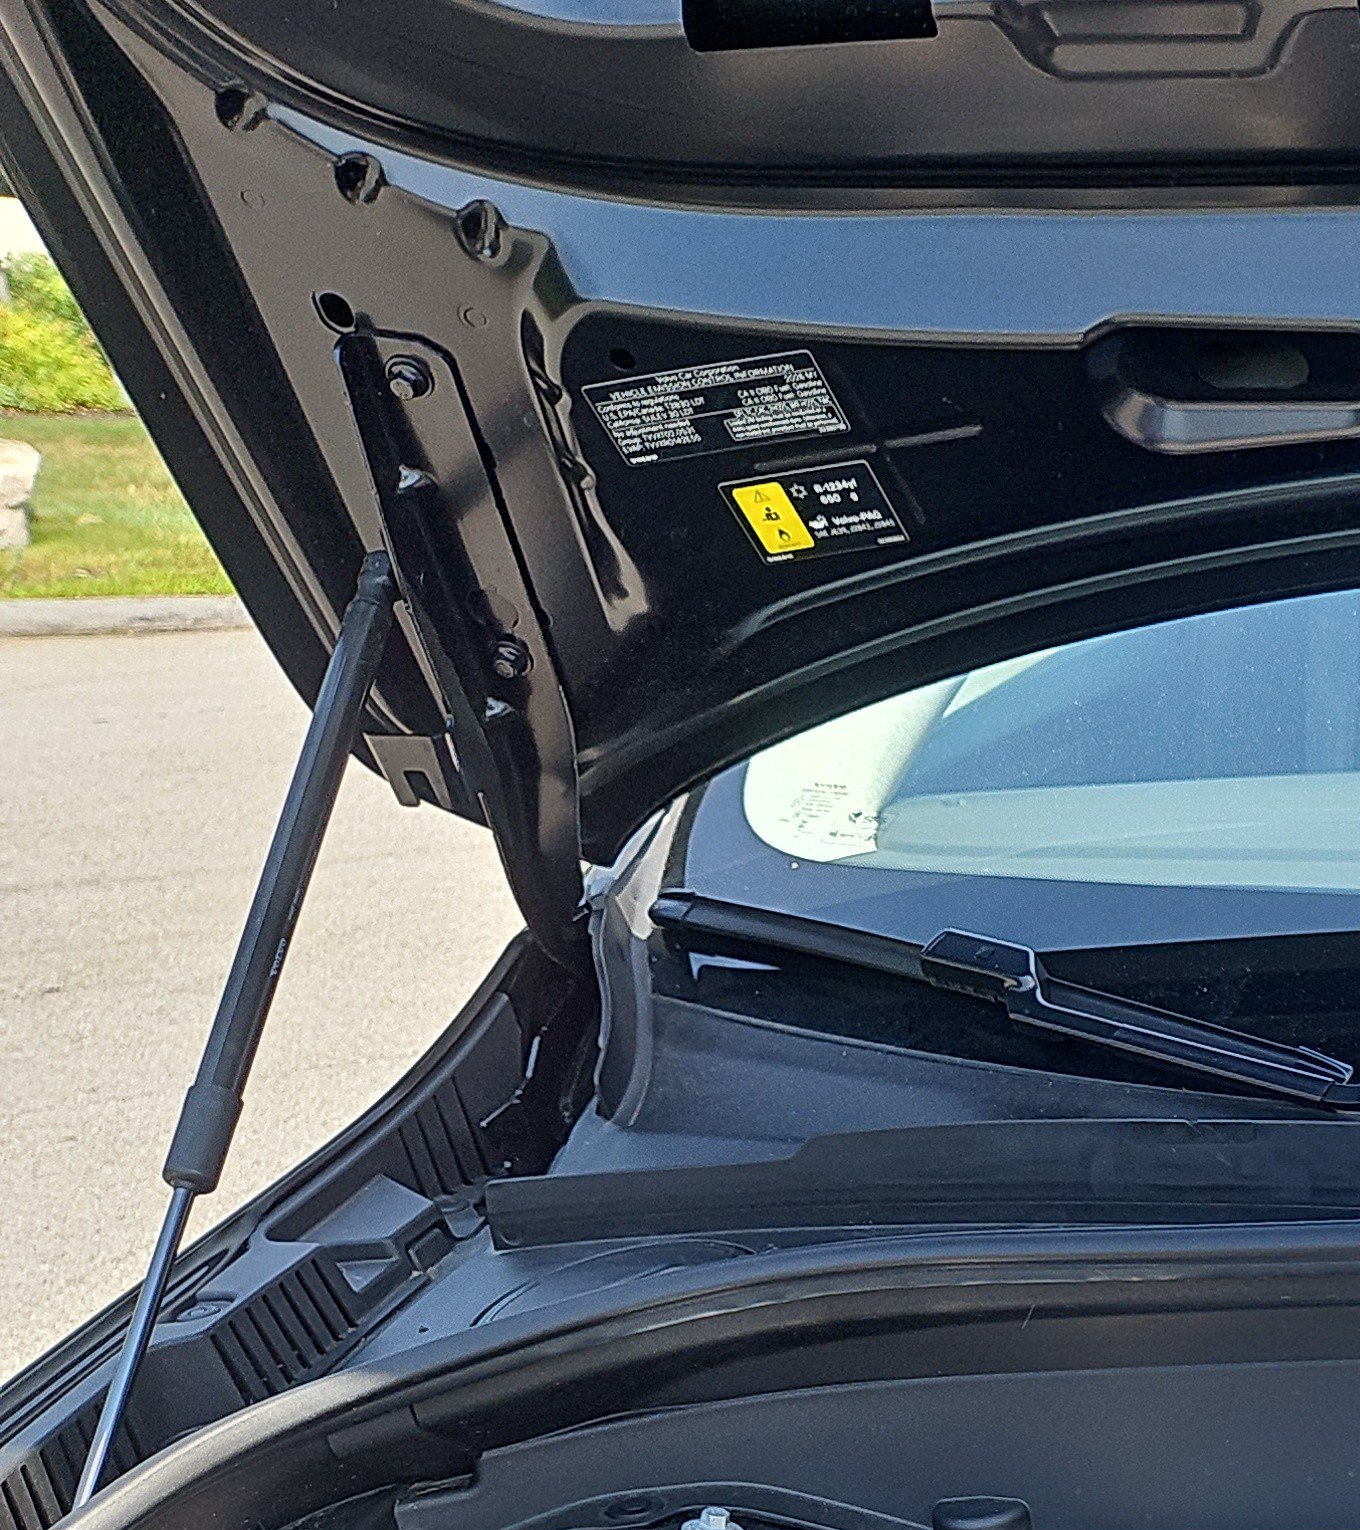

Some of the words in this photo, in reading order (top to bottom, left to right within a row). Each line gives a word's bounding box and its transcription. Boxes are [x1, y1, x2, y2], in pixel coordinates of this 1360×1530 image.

[609, 388, 646, 399] VEHICLE
[647, 381, 691, 393] EMISSION
[691, 374, 732, 386] CONTROL
[733, 363, 793, 378] INFORMATION
[693, 364, 739, 377] Corporation
